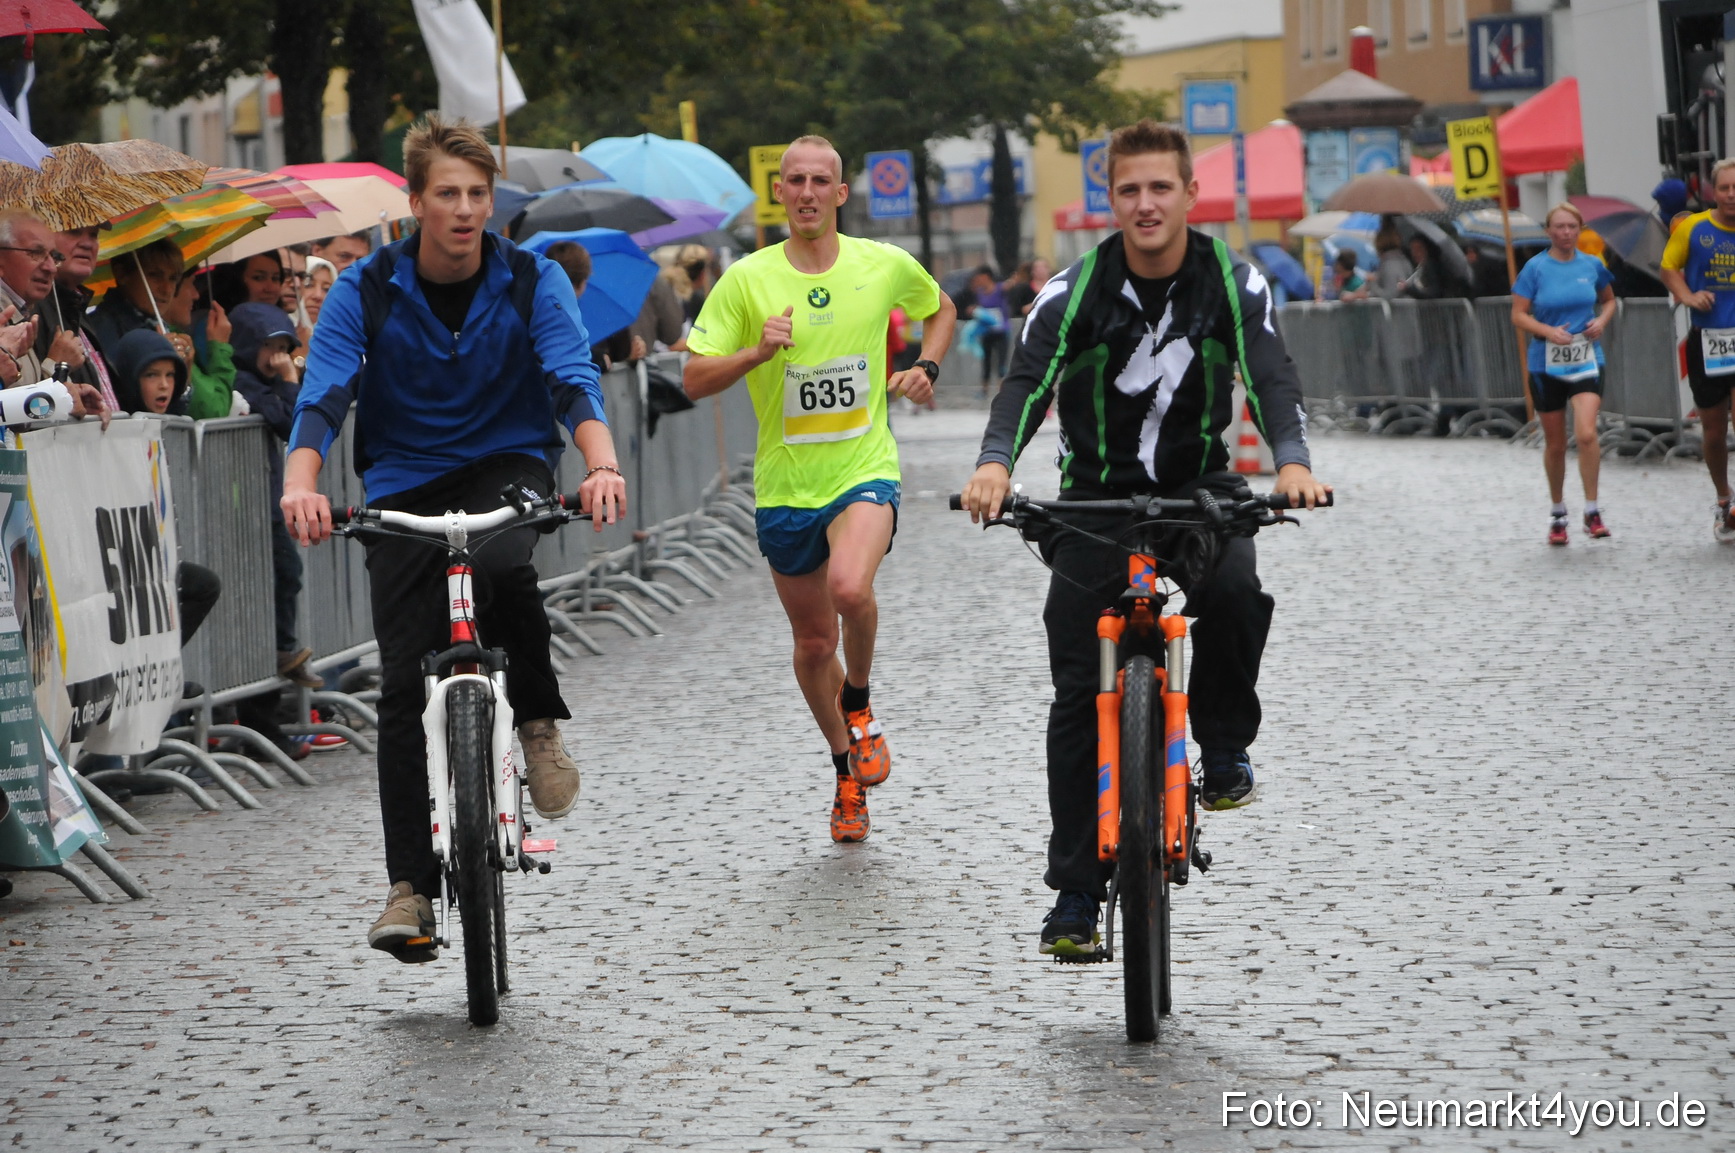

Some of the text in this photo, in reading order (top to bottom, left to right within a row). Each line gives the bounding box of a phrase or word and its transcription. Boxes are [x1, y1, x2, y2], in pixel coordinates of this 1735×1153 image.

[1452, 121, 1492, 139] Block
[1464, 143, 1490, 180] D
[1551, 342, 1590, 363] 2927
[812, 363, 855, 376] Neumarkt
[799, 376, 856, 411] 635
